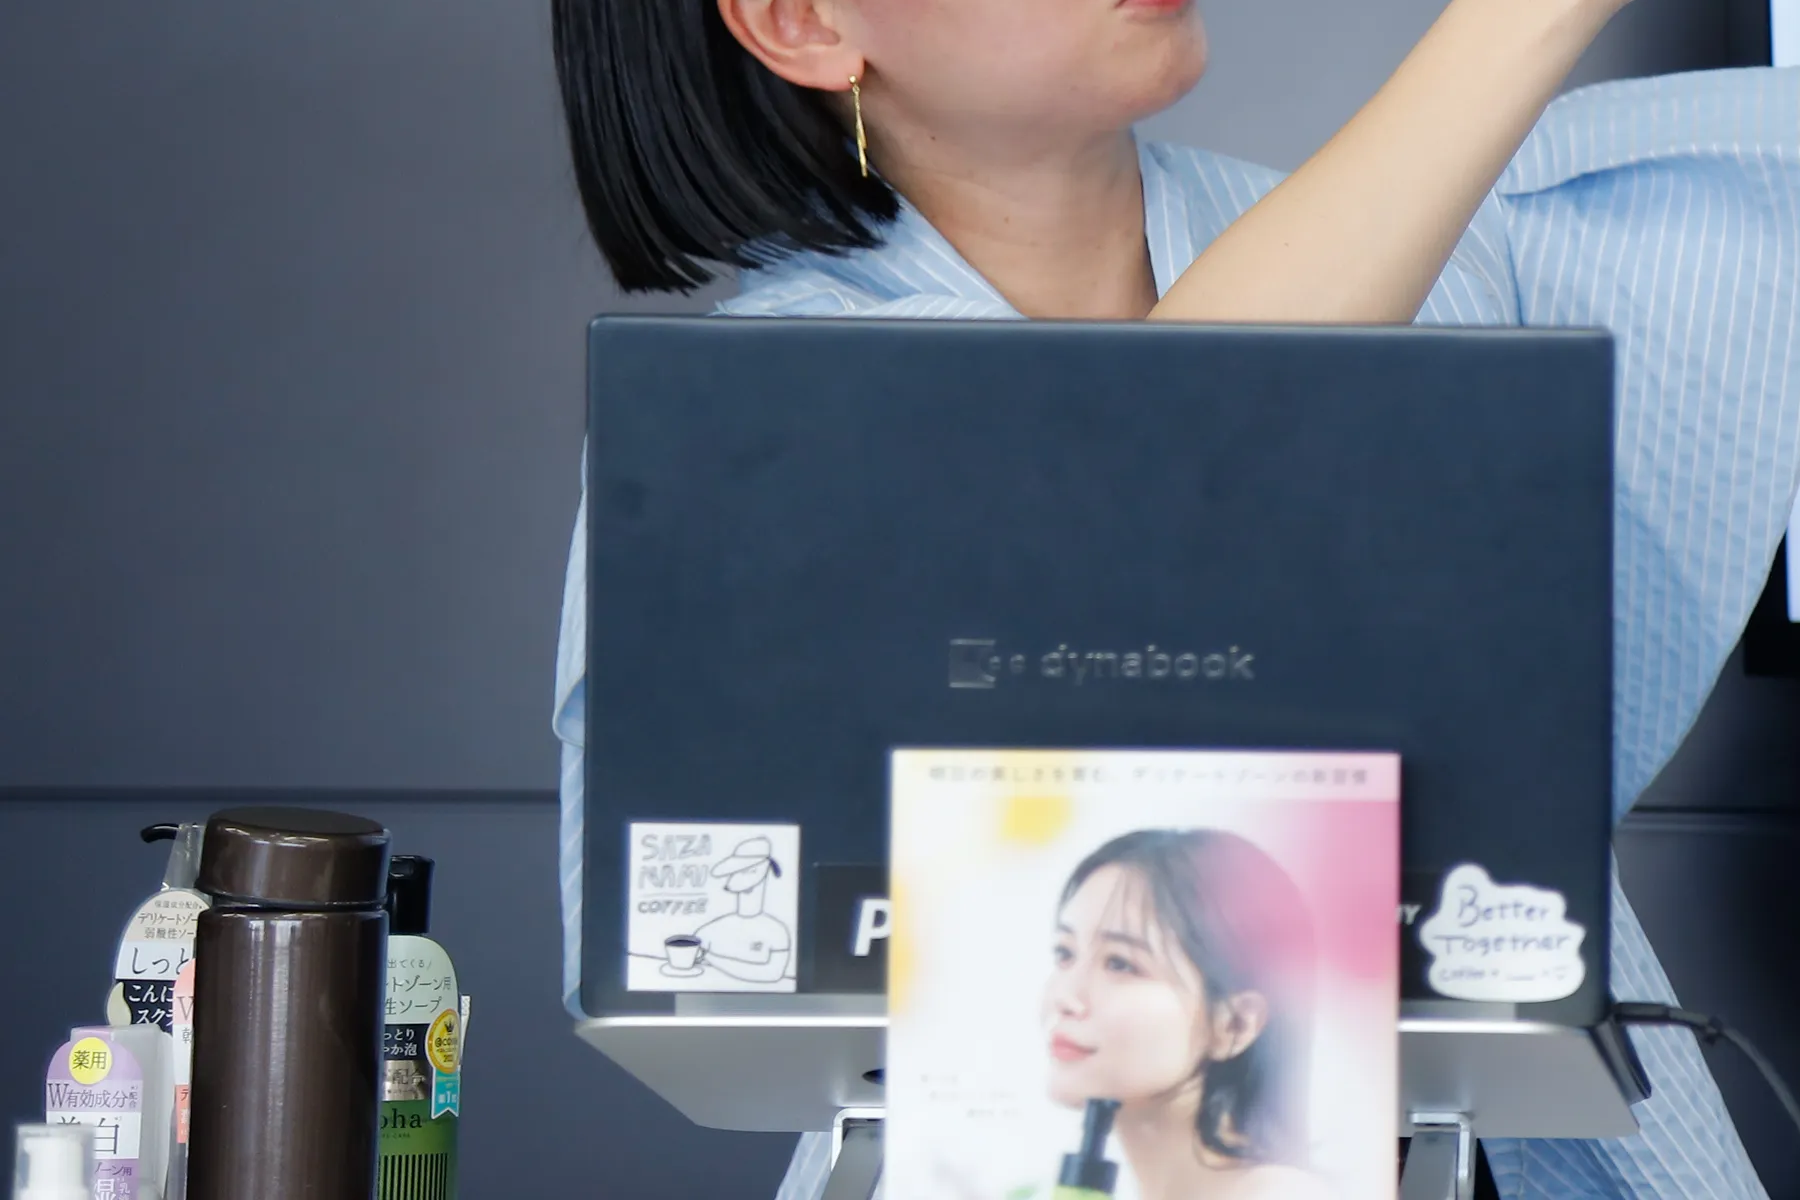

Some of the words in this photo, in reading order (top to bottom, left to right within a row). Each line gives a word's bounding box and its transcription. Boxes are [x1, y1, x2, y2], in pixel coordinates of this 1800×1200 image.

[1041, 644, 1255, 686] dynabook
[1456, 884, 1550, 928] Better
[72, 1050, 108, 1070] 薬用
